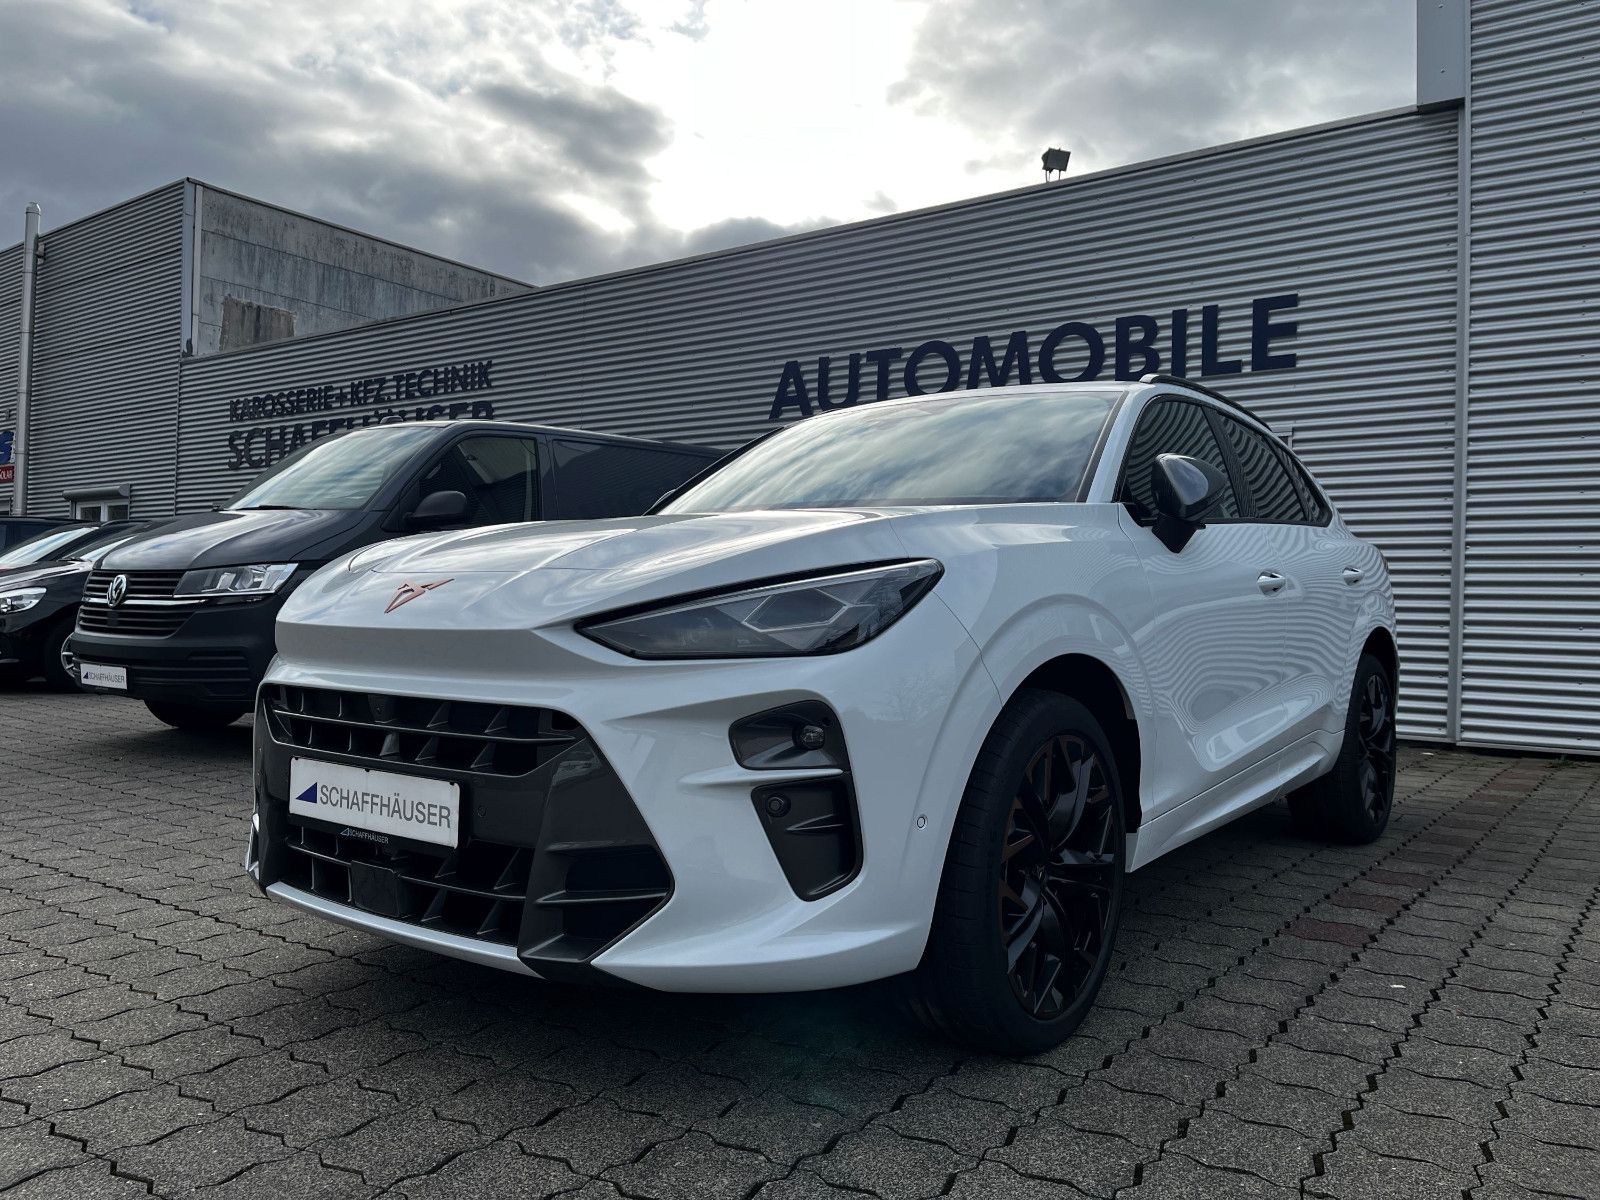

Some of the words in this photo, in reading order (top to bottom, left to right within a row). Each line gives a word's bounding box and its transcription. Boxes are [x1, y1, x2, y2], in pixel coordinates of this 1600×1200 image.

[769, 293, 1298, 419] AUTOMOBILE
[319, 784, 451, 829] SCHAFFHÄUSER
[349, 828, 389, 844] SCHAFFHÄUSER
